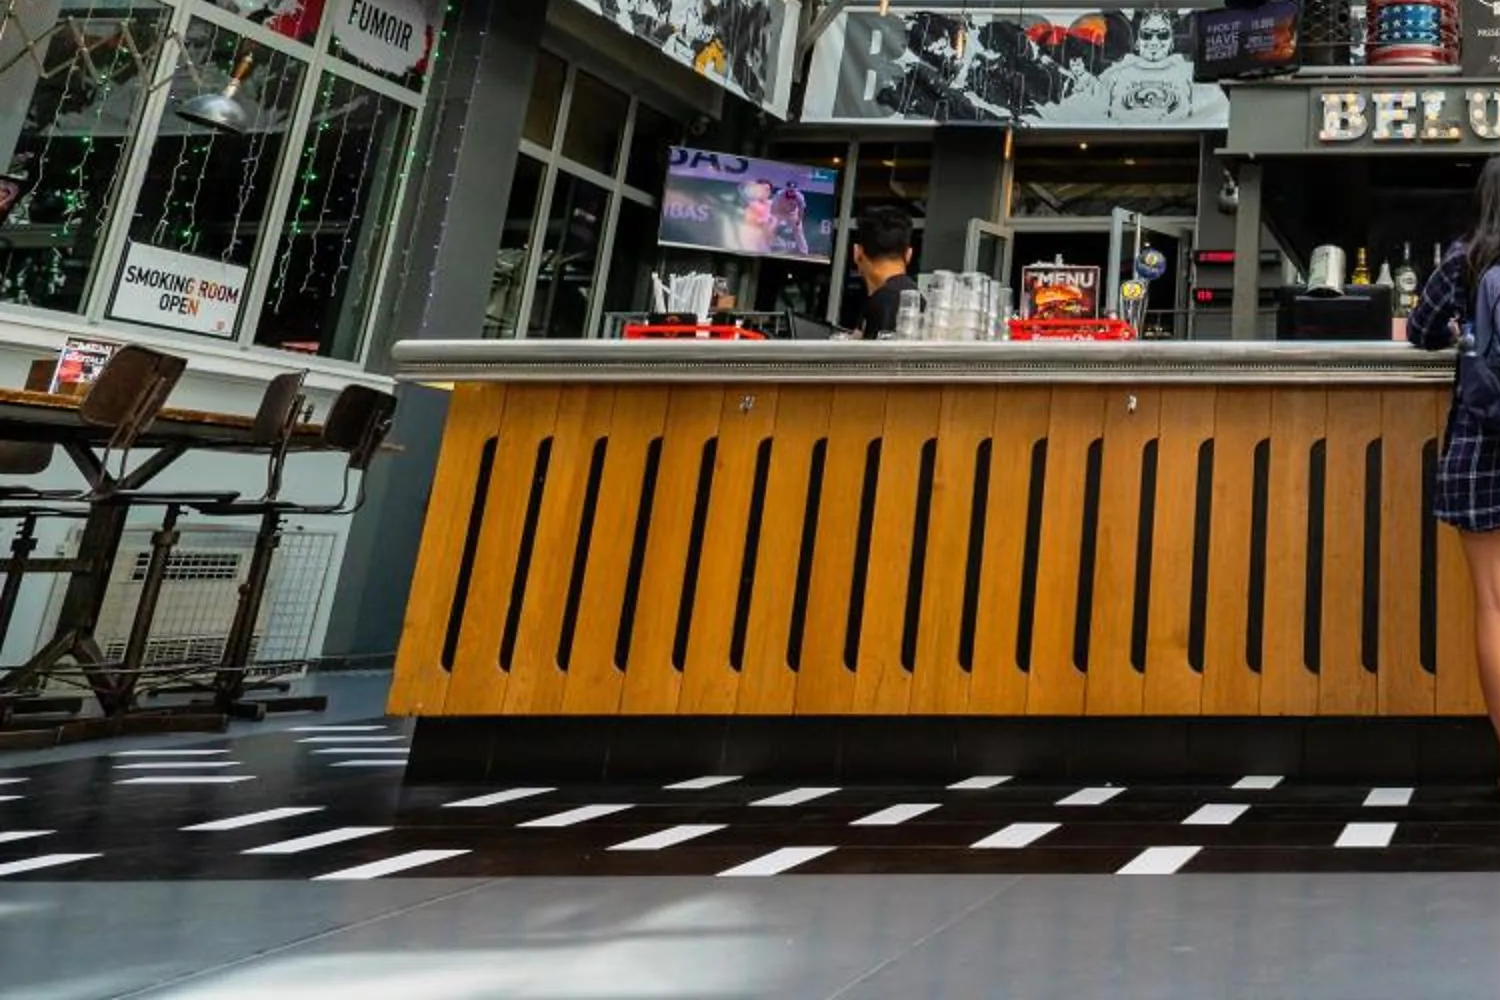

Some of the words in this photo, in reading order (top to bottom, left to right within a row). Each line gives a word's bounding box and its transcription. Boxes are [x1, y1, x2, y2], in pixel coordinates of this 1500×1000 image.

[124, 264, 197, 295] SMOKING
[198, 280, 240, 305] ROOM
[1037, 271, 1095, 289] MENU
[158, 292, 200, 317] OPEN
